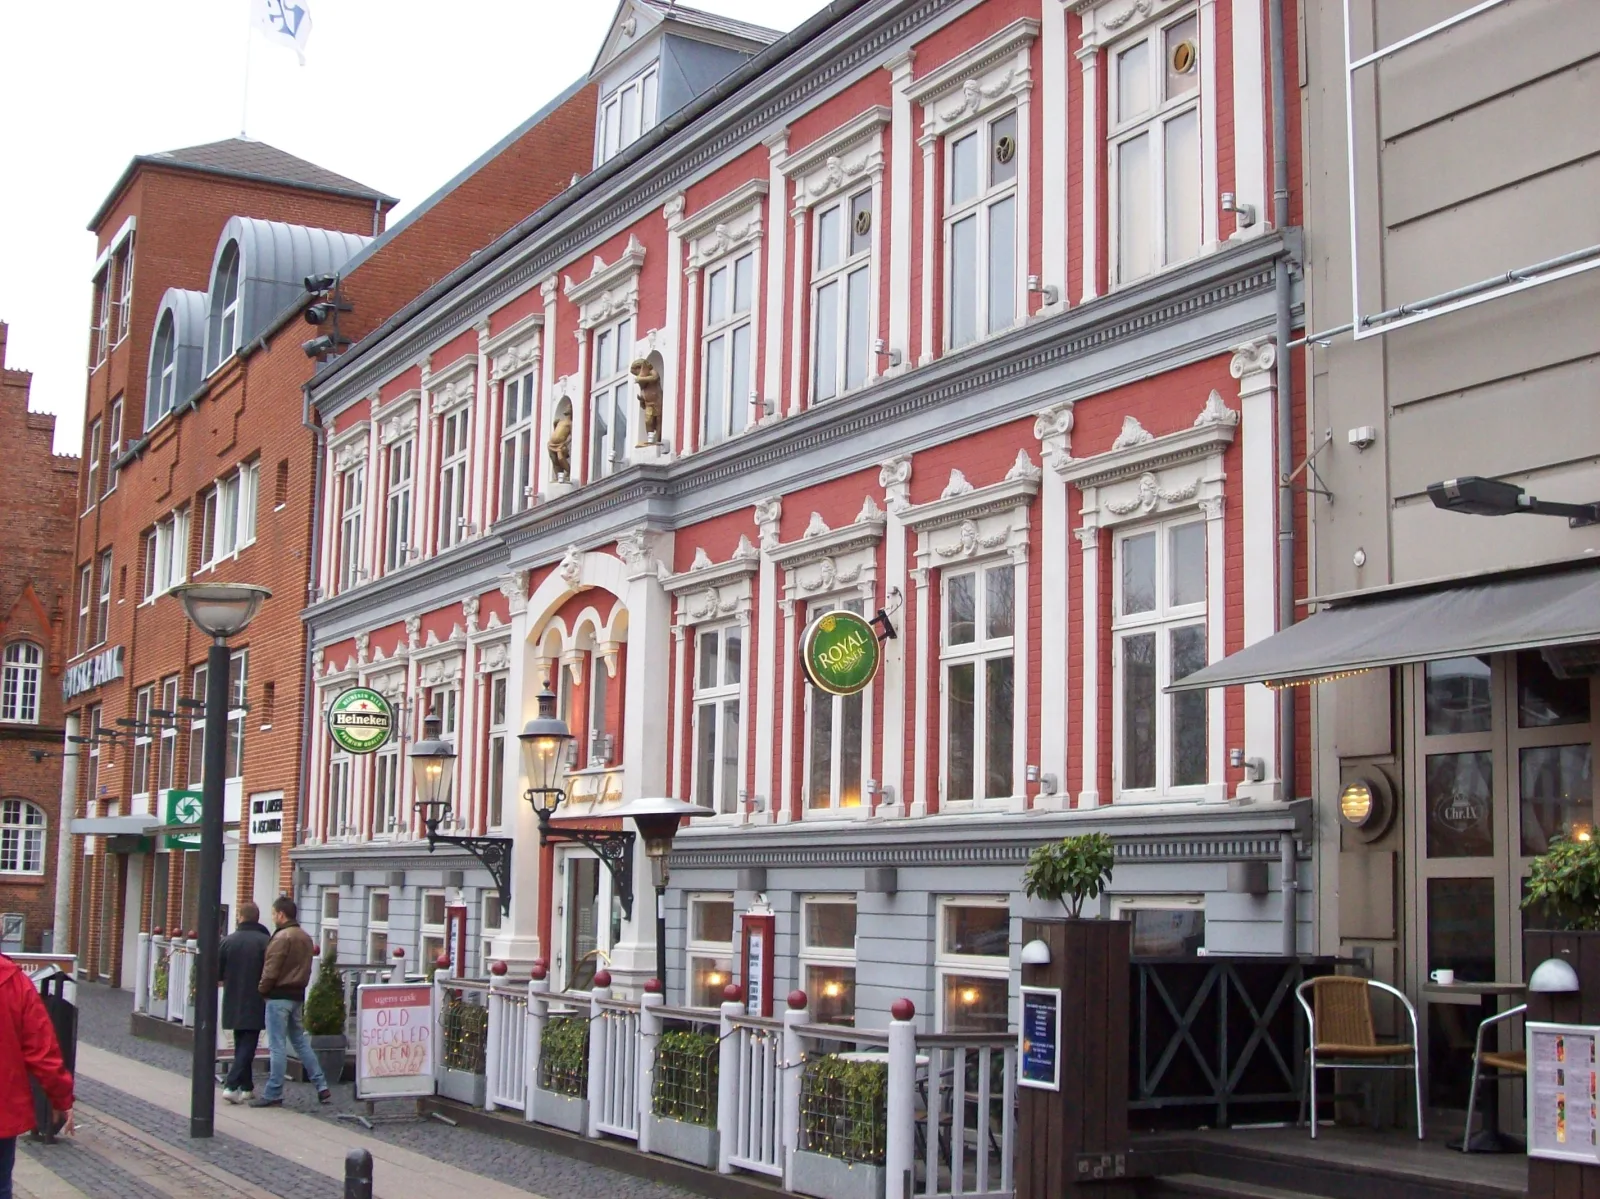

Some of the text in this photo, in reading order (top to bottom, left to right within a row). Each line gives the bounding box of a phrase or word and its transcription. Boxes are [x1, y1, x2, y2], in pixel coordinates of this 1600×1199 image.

[818, 630, 868, 669] ROYAL
[831, 647, 866, 674] PILSNER
[336, 713, 387, 726] Heineken
[374, 996, 398, 1004] ugens
[376, 1008, 410, 1027] OLD
[361, 1026, 430, 1046] SPECKLED
[376, 1045, 411, 1061] HEN
